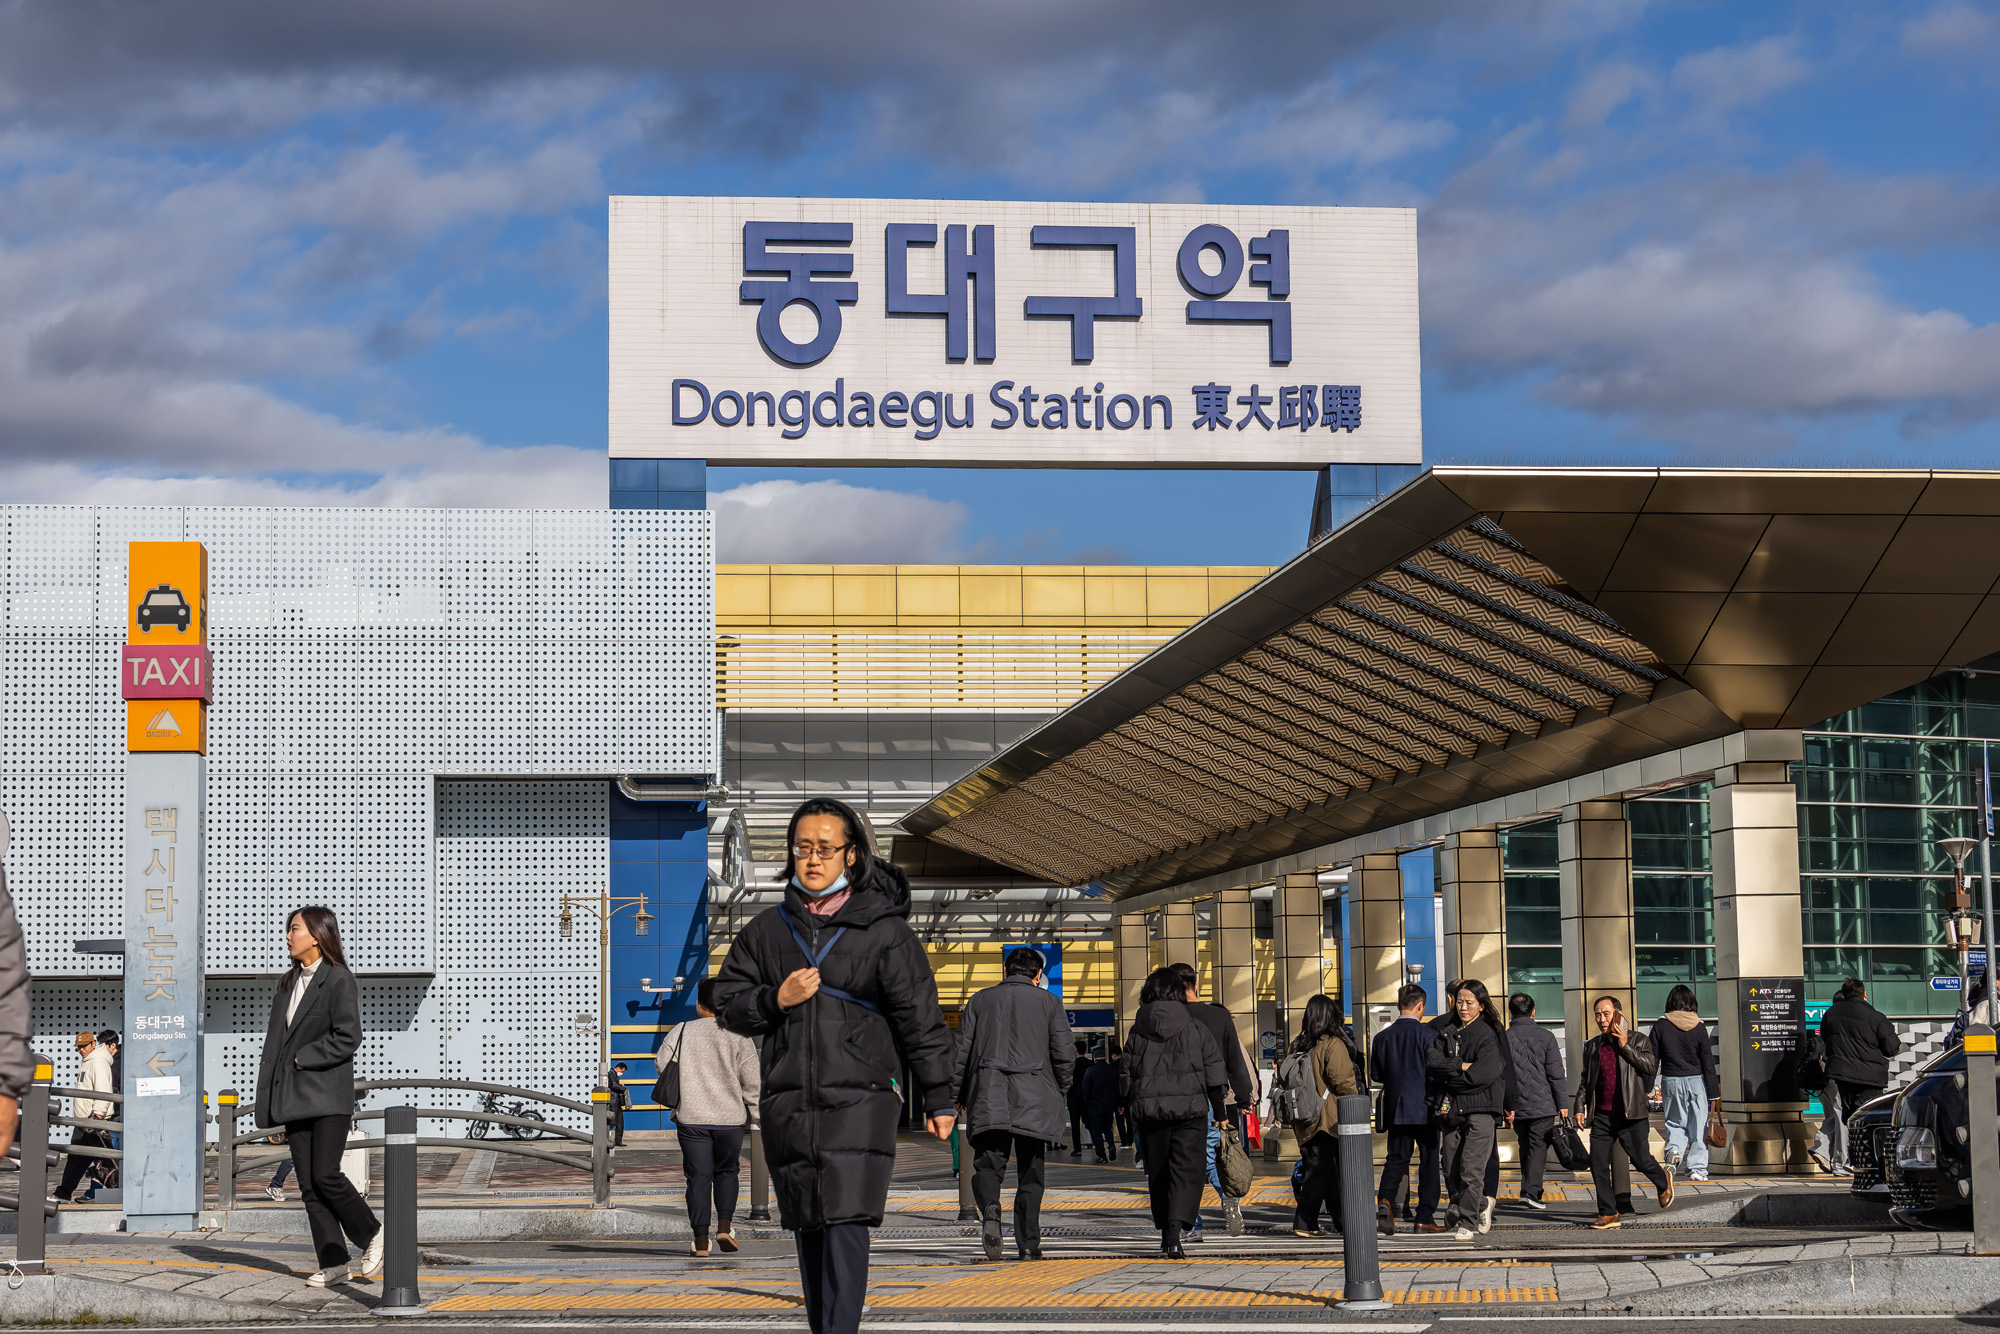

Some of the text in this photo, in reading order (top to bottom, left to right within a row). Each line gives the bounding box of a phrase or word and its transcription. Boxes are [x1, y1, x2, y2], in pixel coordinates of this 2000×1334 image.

[740, 220, 1293, 368] 동대구역
[671, 377, 1363, 441] Dongdaegu Station 東大邱驛
[126, 657, 200, 687] TAXI
[135, 1015, 185, 1030] 동대구역
[1068, 1011, 1076, 1025] 3
[132, 1031, 188, 1041] Dongdaegu Stn.
